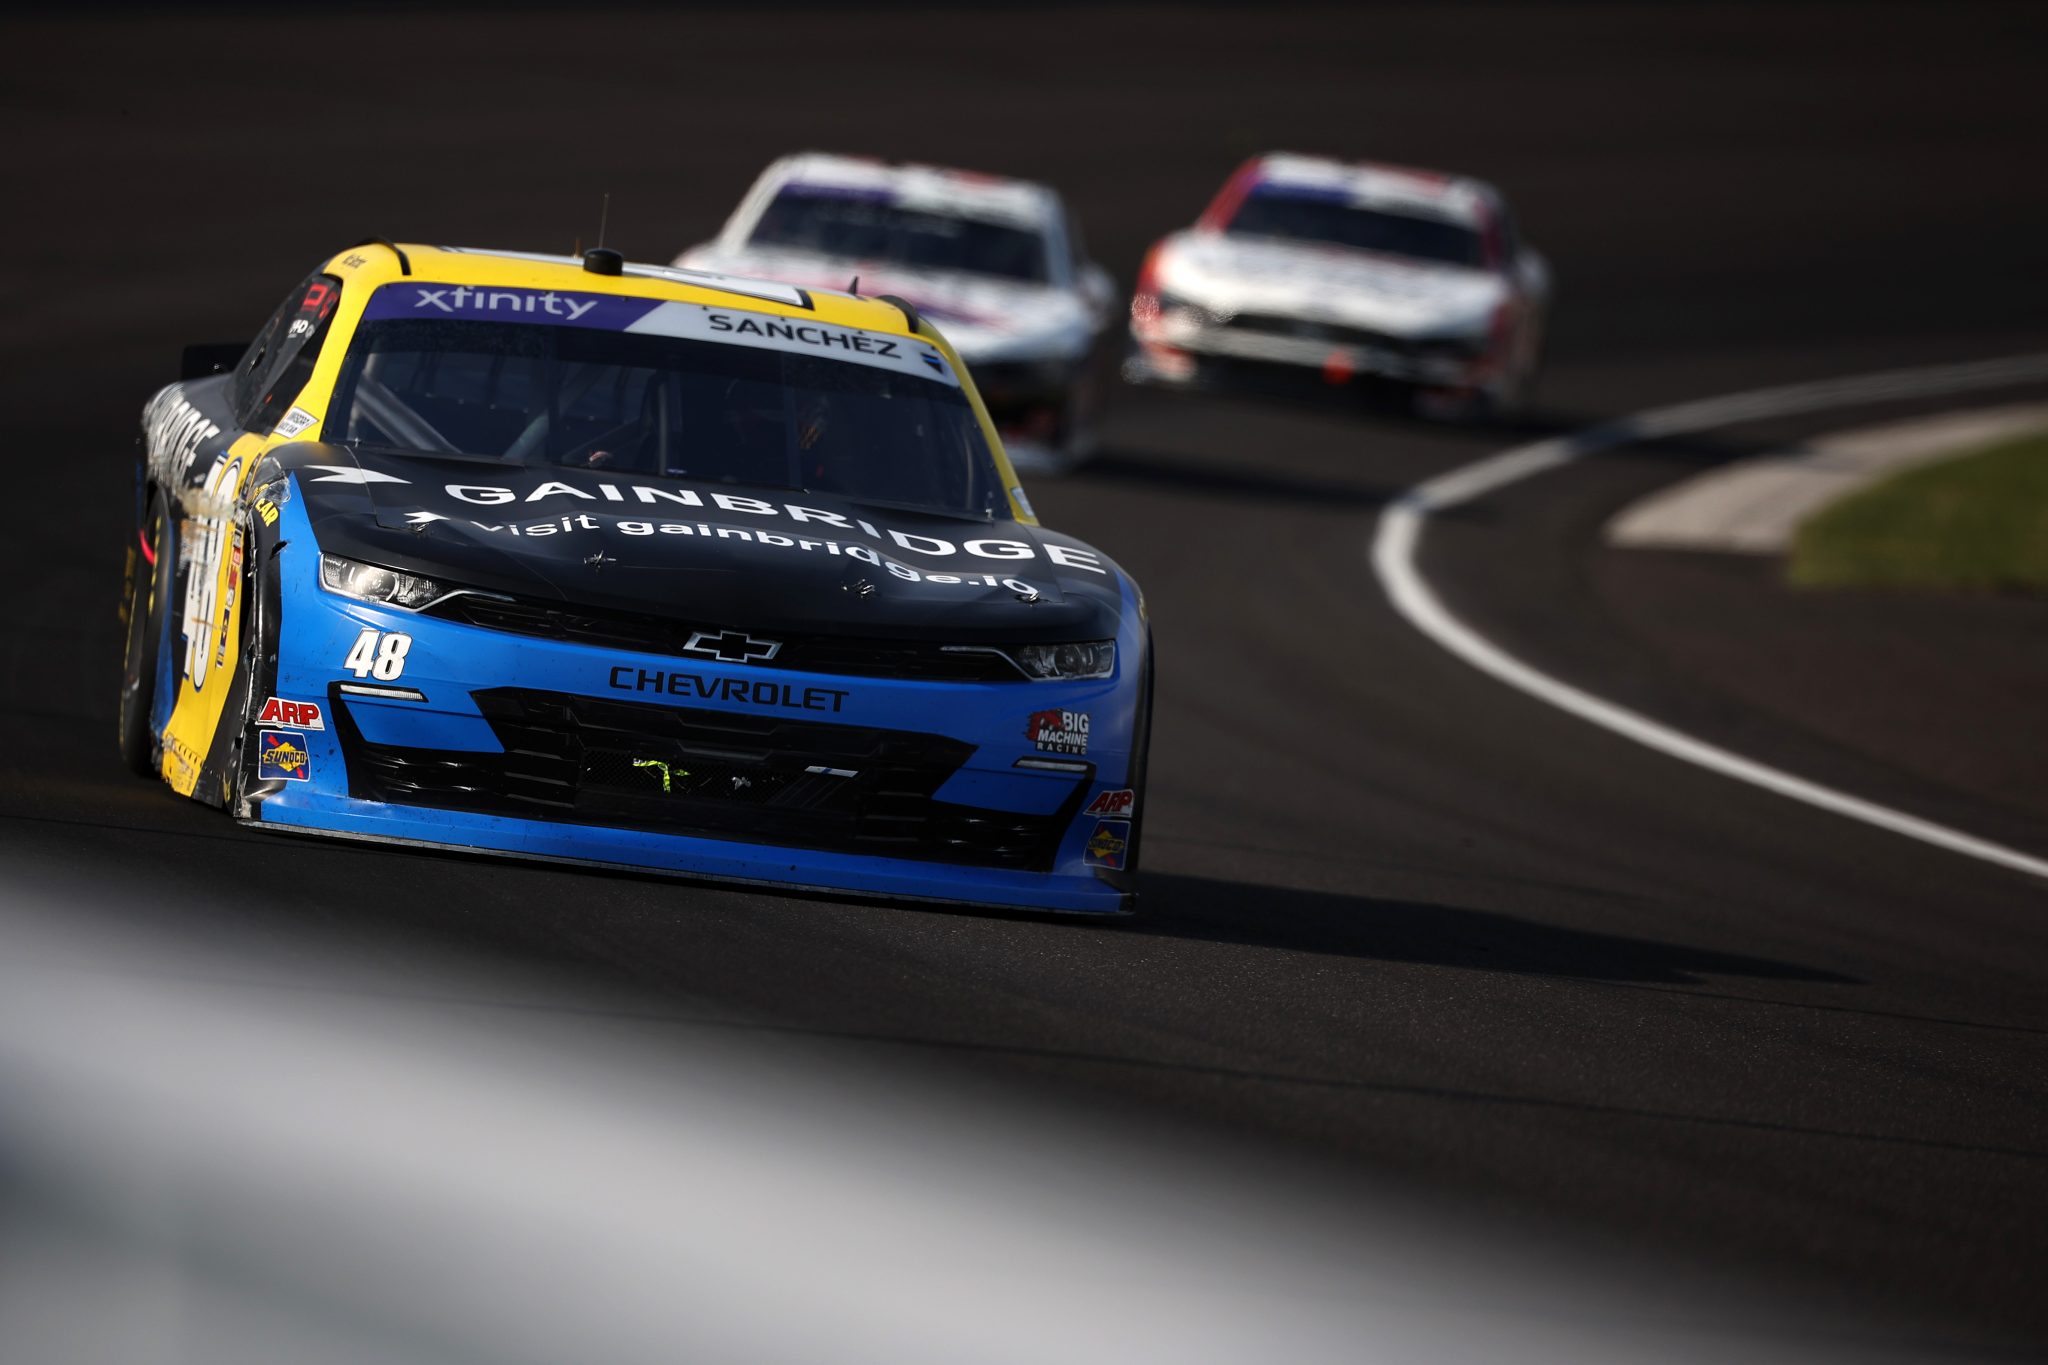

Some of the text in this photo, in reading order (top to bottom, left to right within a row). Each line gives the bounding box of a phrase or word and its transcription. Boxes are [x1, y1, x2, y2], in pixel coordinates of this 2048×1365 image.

[415, 285, 598, 320] xfinity
[708, 311, 902, 359] SANCHEZ
[445, 482, 1106, 574] GAINBRIDGE
[470, 514, 1039, 595] visit gainbridge.io
[344, 627, 413, 681] 48
[609, 666, 850, 712] CHEVROLET
[260, 699, 320, 725] ARP
[1062, 711, 1089, 734] BIG
[1037, 728, 1089, 747] MACHINE
[1037, 742, 1088, 755] RACING
[266, 750, 306, 764] SUNOCO
[1090, 791, 1133, 811] ARP
